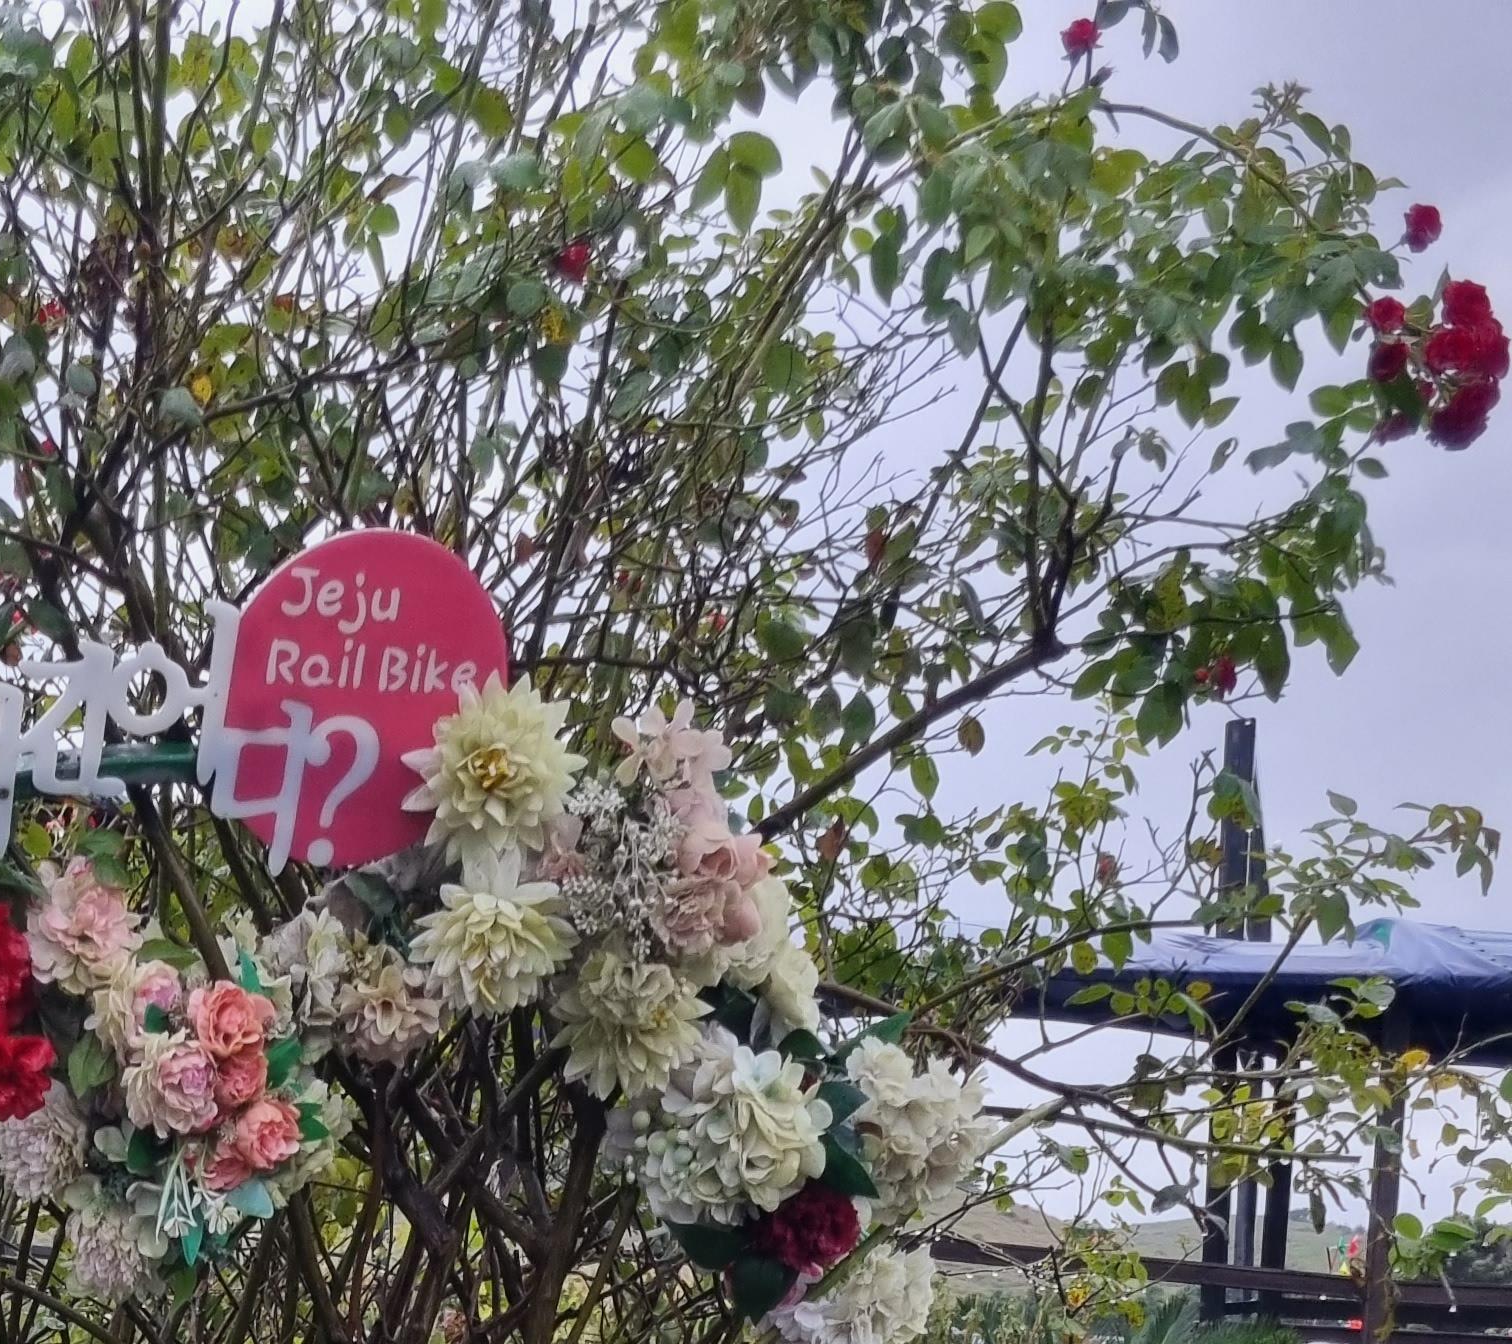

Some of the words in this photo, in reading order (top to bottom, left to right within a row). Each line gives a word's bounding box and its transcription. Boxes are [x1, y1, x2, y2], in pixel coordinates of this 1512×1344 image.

[281, 566, 400, 634] Jeju
[265, 638, 365, 690] Rail
[378, 643, 477, 694] Bike
